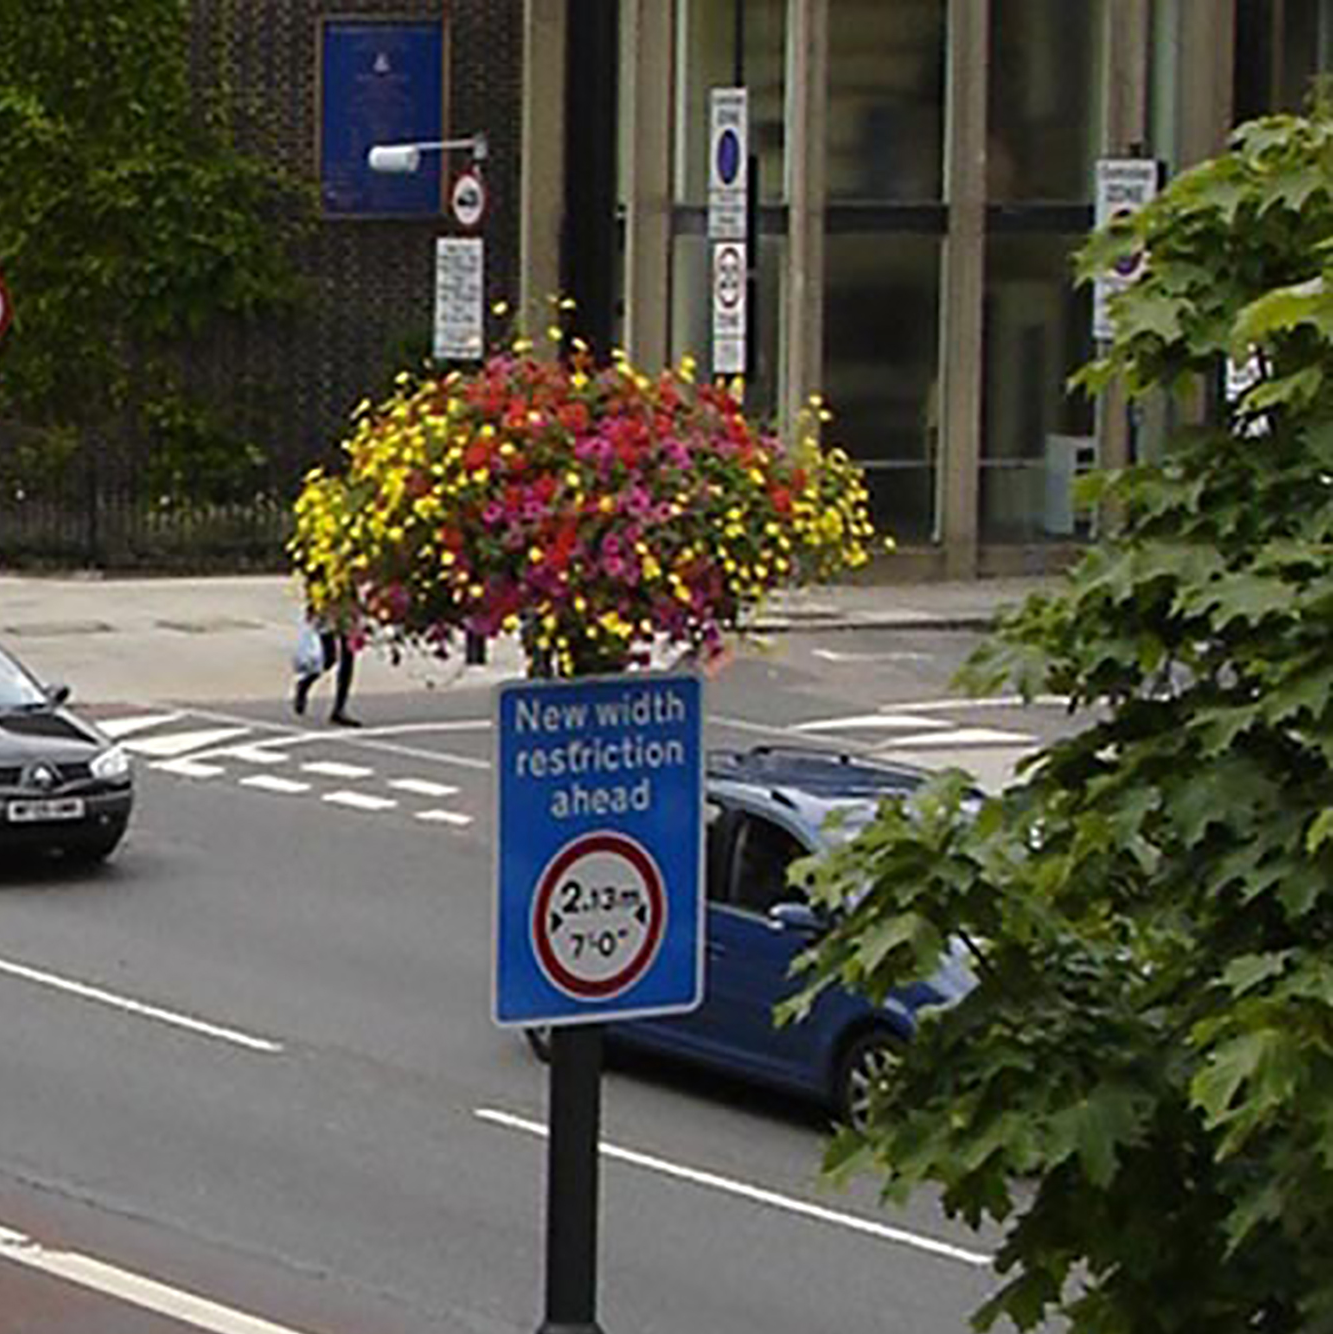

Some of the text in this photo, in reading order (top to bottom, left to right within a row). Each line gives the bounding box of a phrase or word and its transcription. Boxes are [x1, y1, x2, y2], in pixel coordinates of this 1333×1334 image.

[515, 690, 685, 732] New width
[515, 734, 684, 778] restriction
[550, 776, 651, 819] ahead
